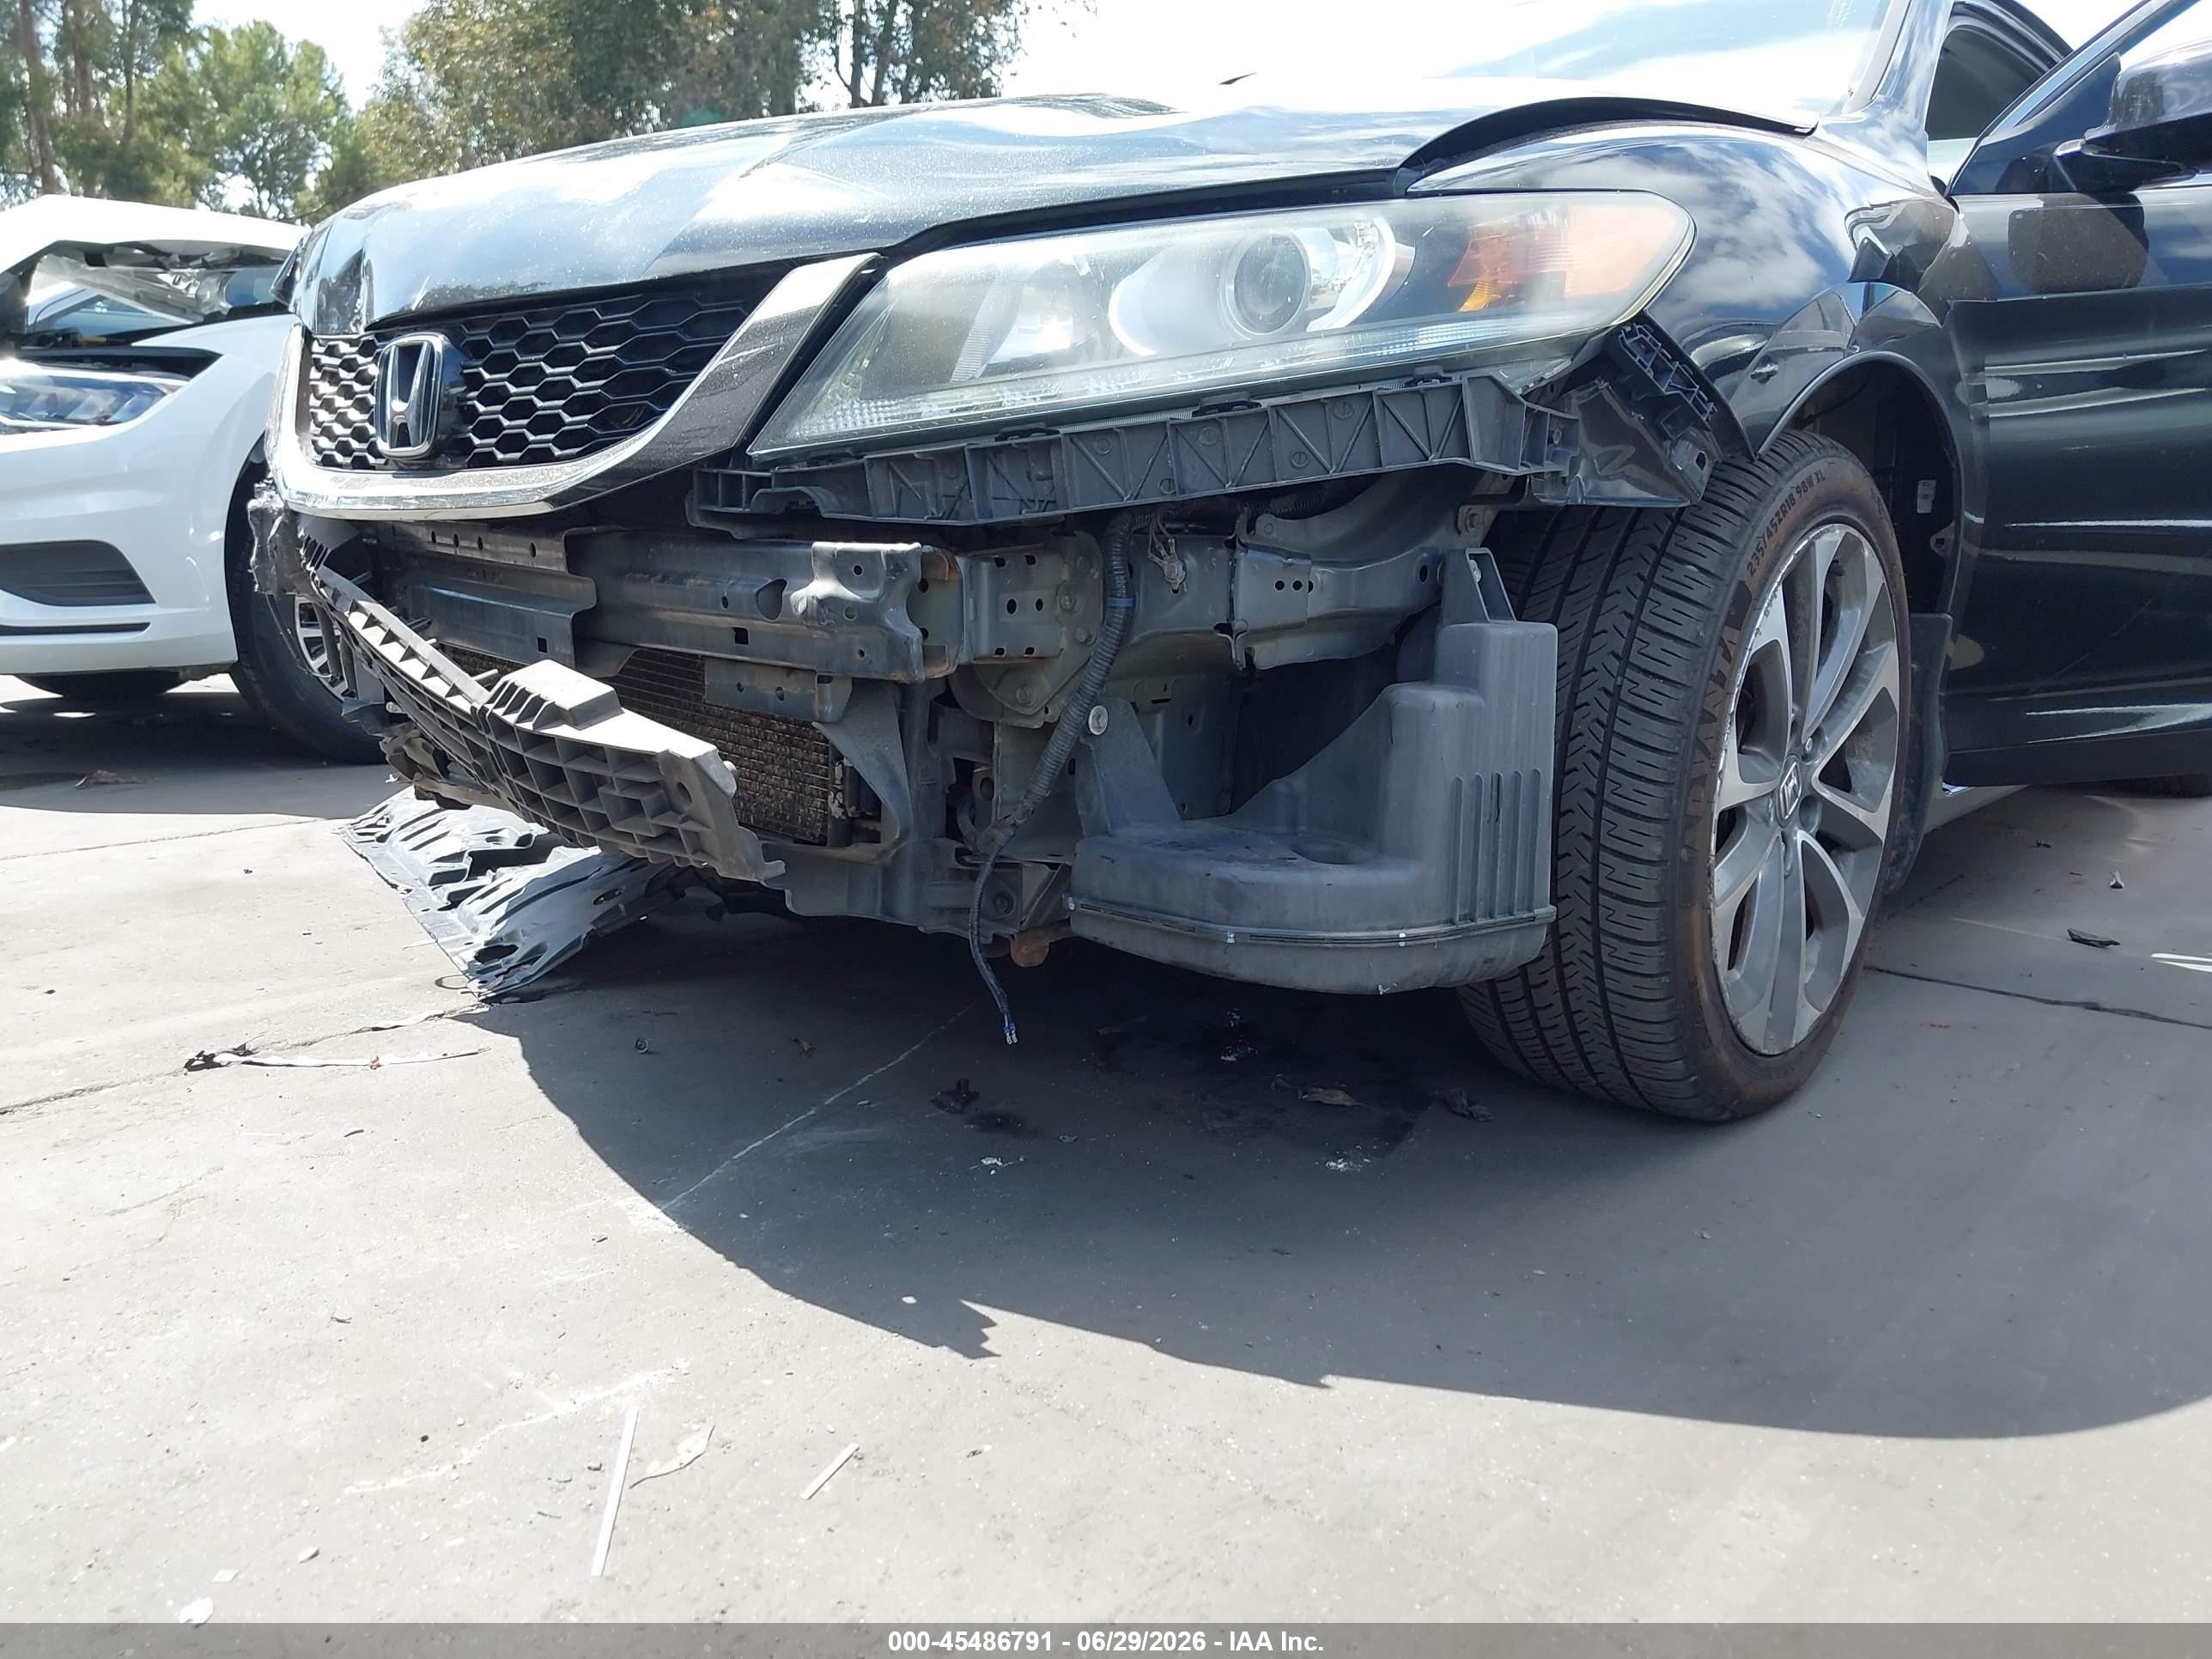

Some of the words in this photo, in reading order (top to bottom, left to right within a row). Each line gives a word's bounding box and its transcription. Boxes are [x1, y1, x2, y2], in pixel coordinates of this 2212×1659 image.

[1747, 494, 1796, 577] 235/45ZR18
[1795, 476, 1814, 499] 98W
[1814, 470, 1826, 483] XL
